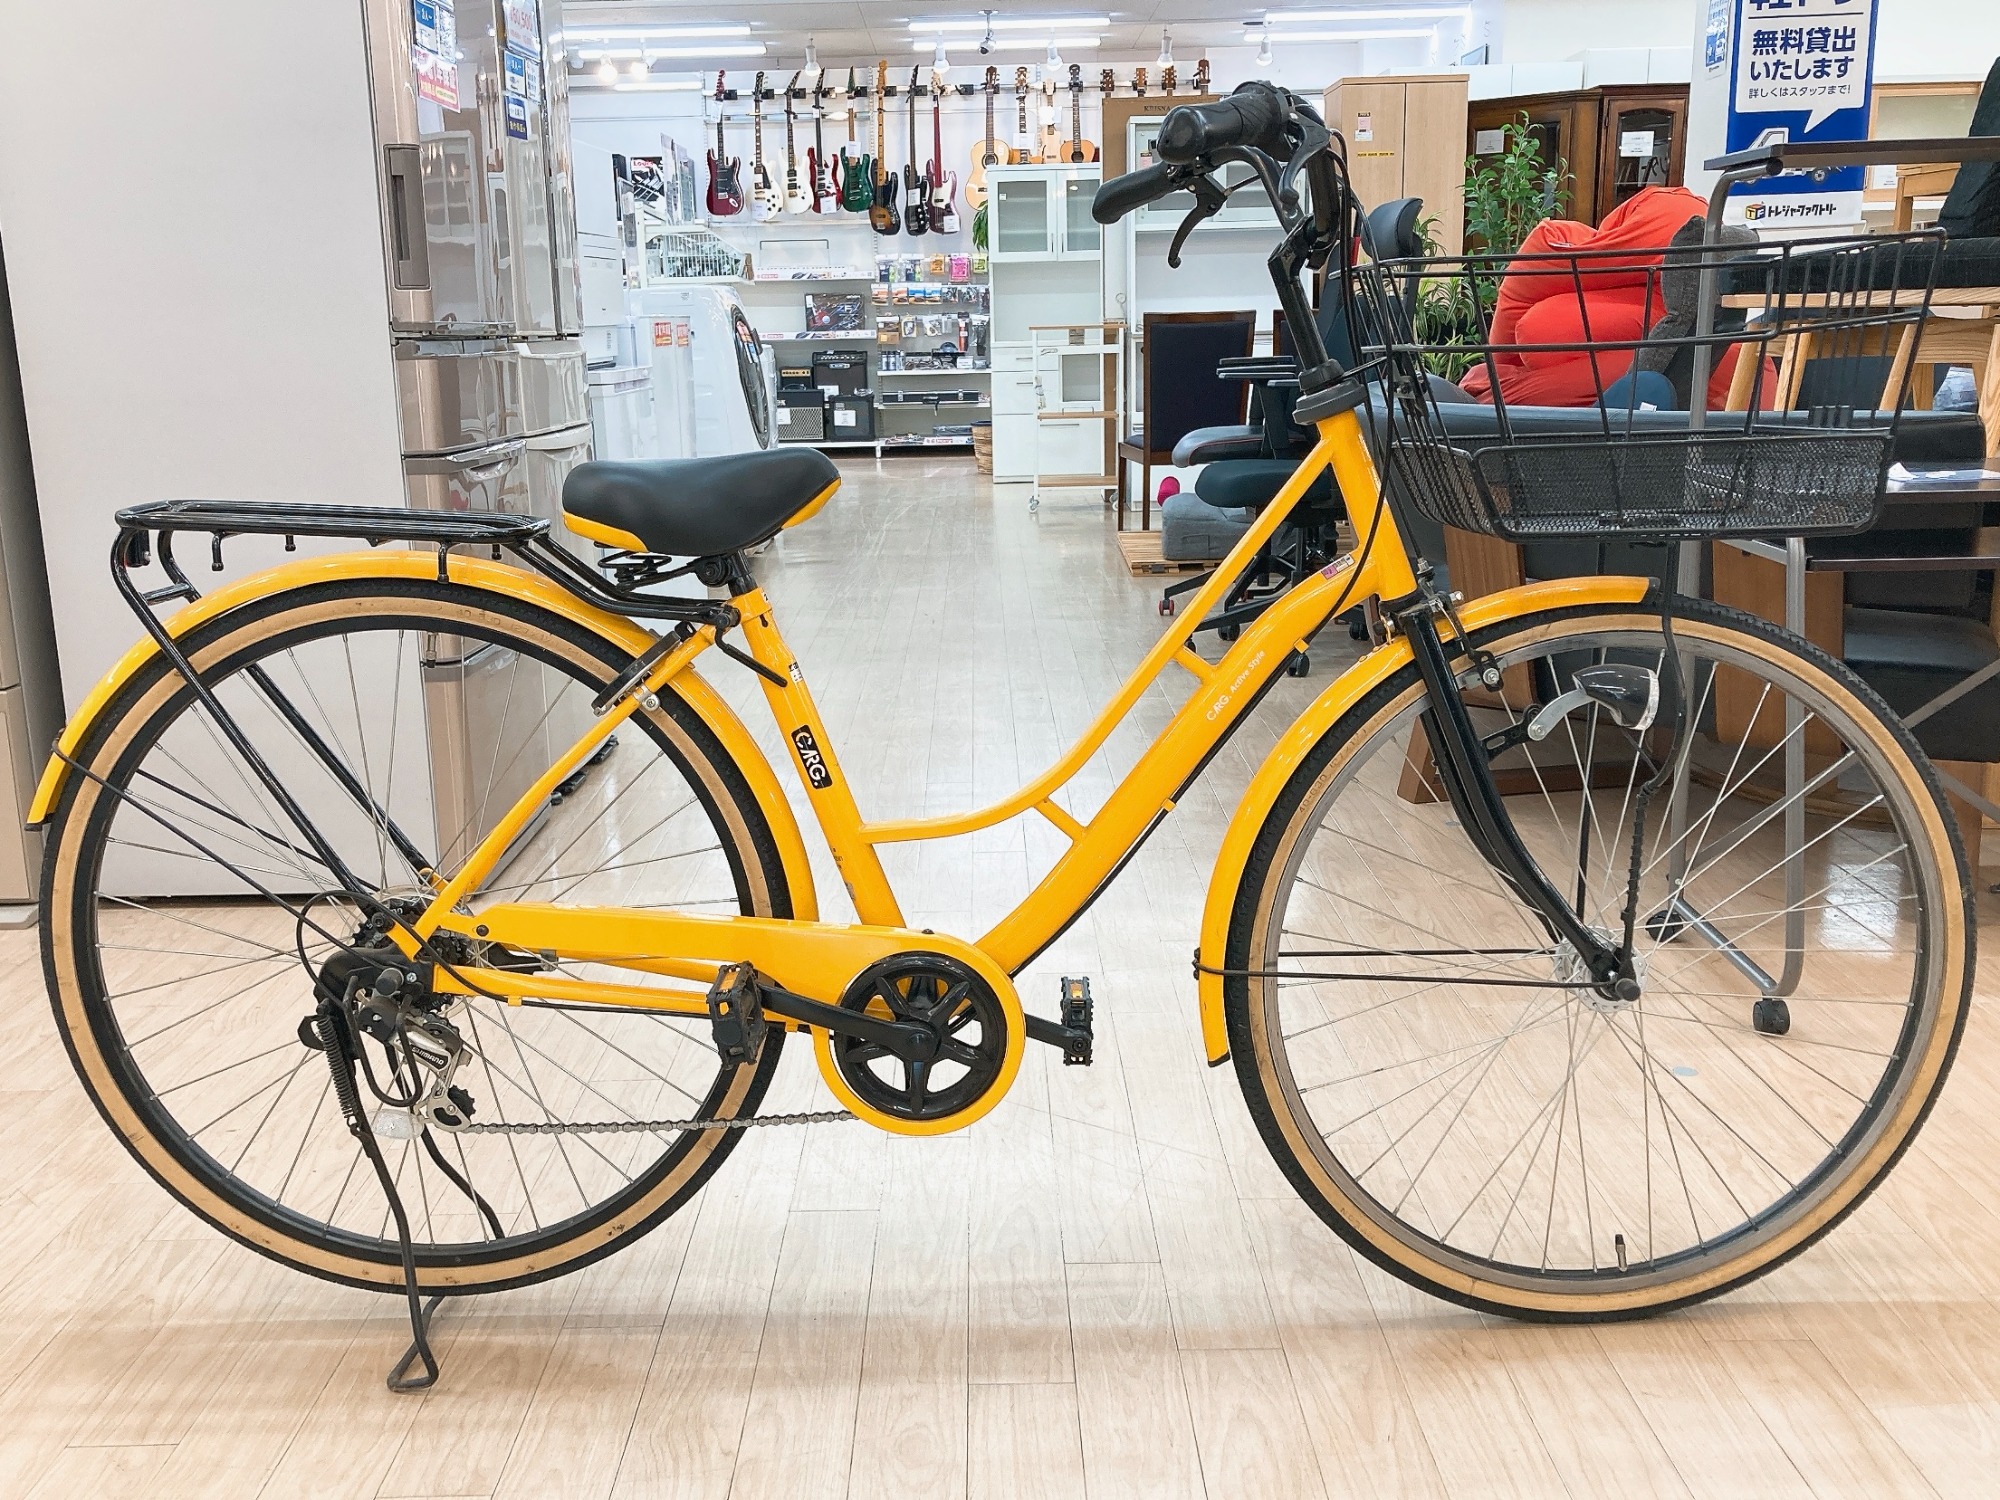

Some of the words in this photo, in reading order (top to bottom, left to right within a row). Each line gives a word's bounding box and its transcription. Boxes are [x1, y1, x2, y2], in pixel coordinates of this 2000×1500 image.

[1752, 26, 1856, 56] 無料貸出
[1750, 56, 1855, 81] いたします
[1767, 204, 1837, 218] トレジャーファクトリー
[1229, 669, 1250, 693] Active
[1248, 650, 1265, 670] Style
[411, 1046, 444, 1066] SHIMANO
